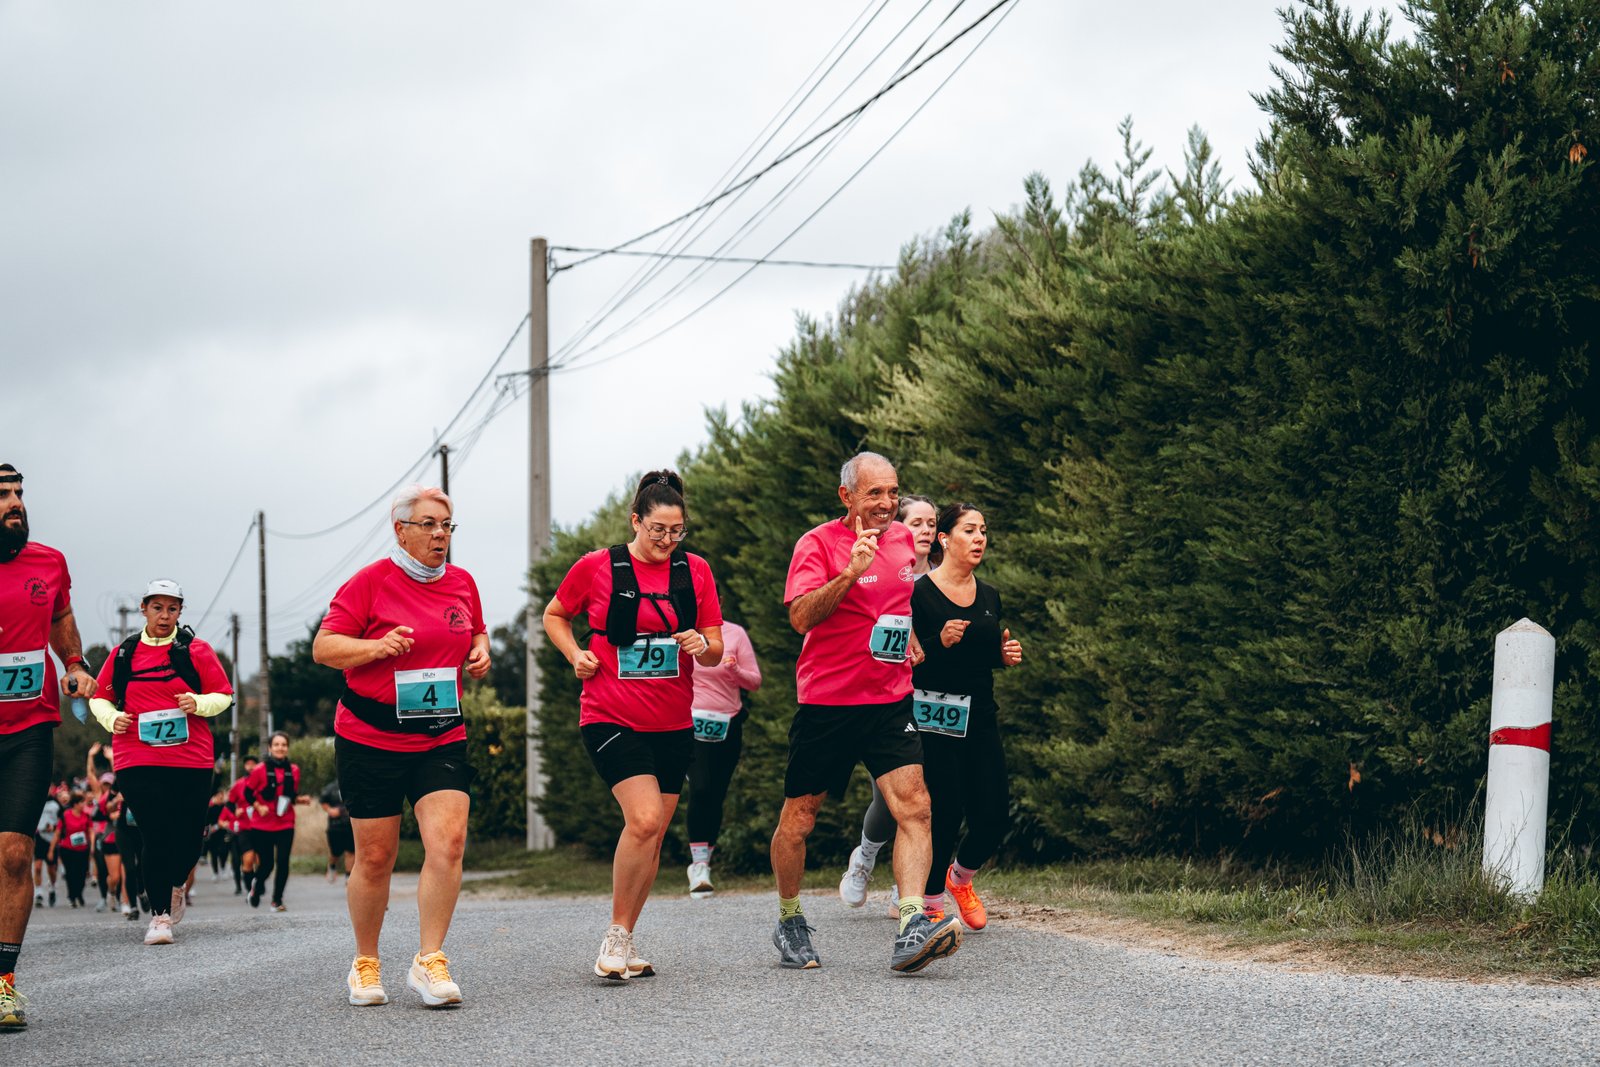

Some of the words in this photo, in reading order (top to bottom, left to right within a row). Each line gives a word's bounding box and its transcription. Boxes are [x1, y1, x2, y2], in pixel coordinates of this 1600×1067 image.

[859, 575, 877, 584] 2020
[882, 629, 909, 653] 725
[634, 647, 665, 669] 79
[2, 667, 34, 691] 73
[422, 684, 439, 707] 4
[917, 703, 961, 727] 349
[151, 721, 177, 739] 72
[694, 719, 724, 737] 362
